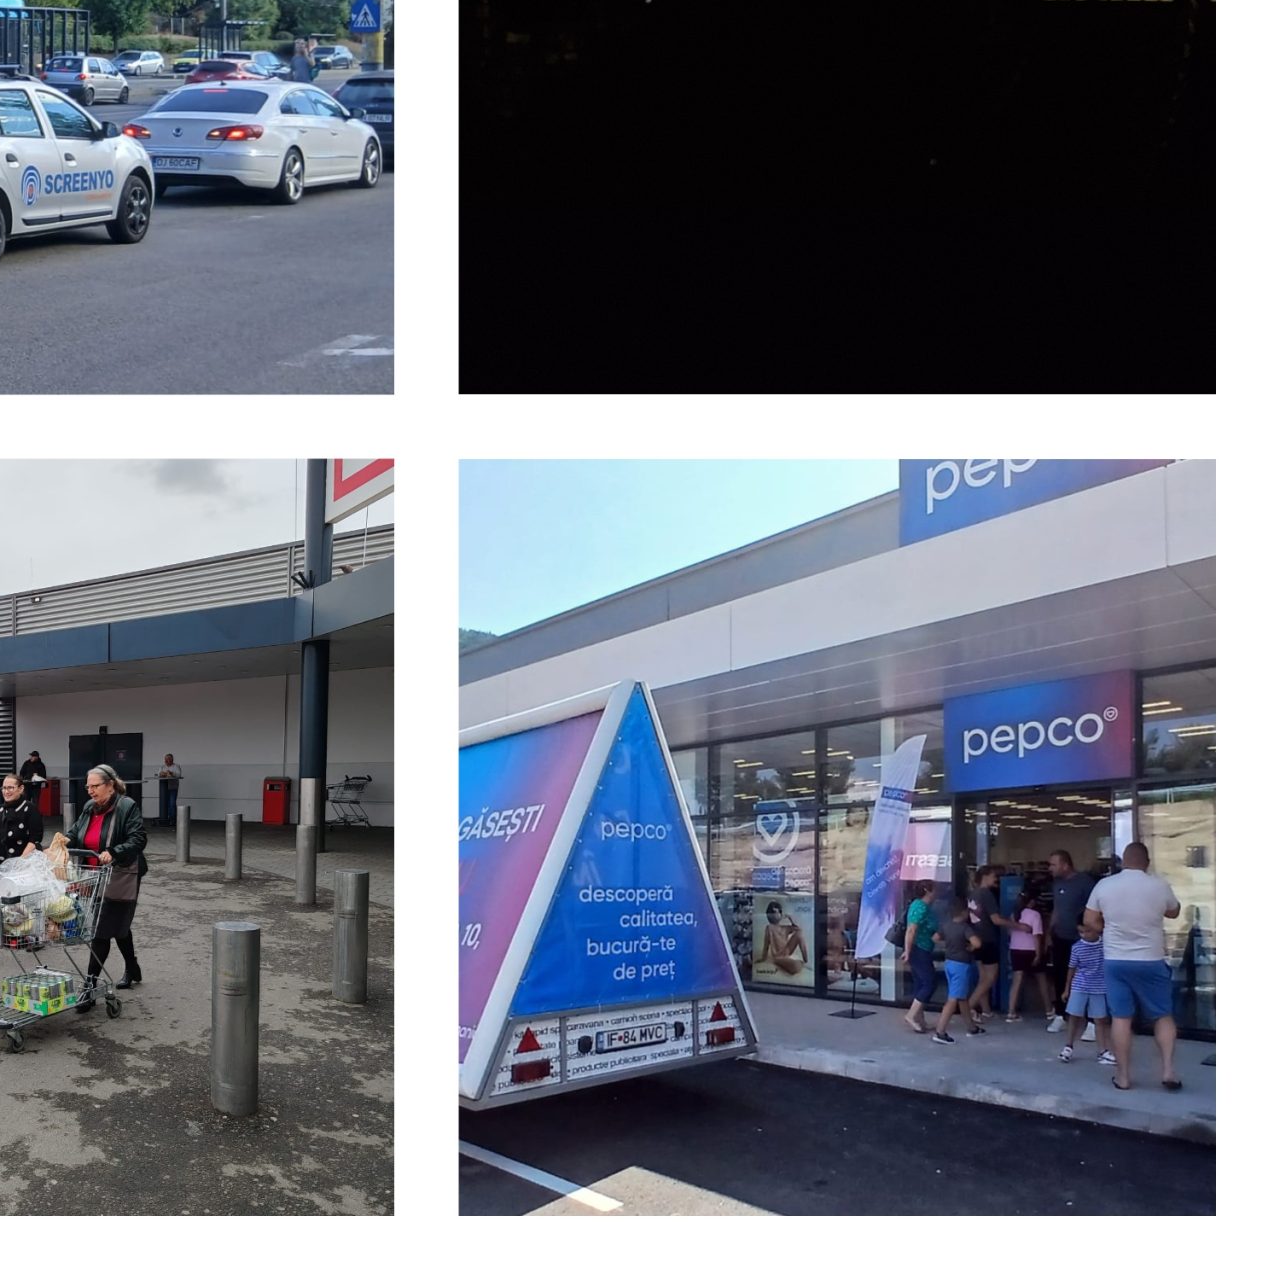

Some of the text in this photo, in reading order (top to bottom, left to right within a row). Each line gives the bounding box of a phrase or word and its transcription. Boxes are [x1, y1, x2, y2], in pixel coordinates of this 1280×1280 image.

[44, 169, 114, 195] SCREENYO
[964, 712, 1104, 764] pepco
[601, 819, 667, 842] pepco
[579, 885, 674, 906] descoperă
[619, 909, 698, 928] calitatea,
[461, 923, 481, 950] 10,
[587, 935, 677, 957] bucură-te
[613, 960, 677, 982] de preț
[607, 1025, 663, 1047] IF 84 MVC
